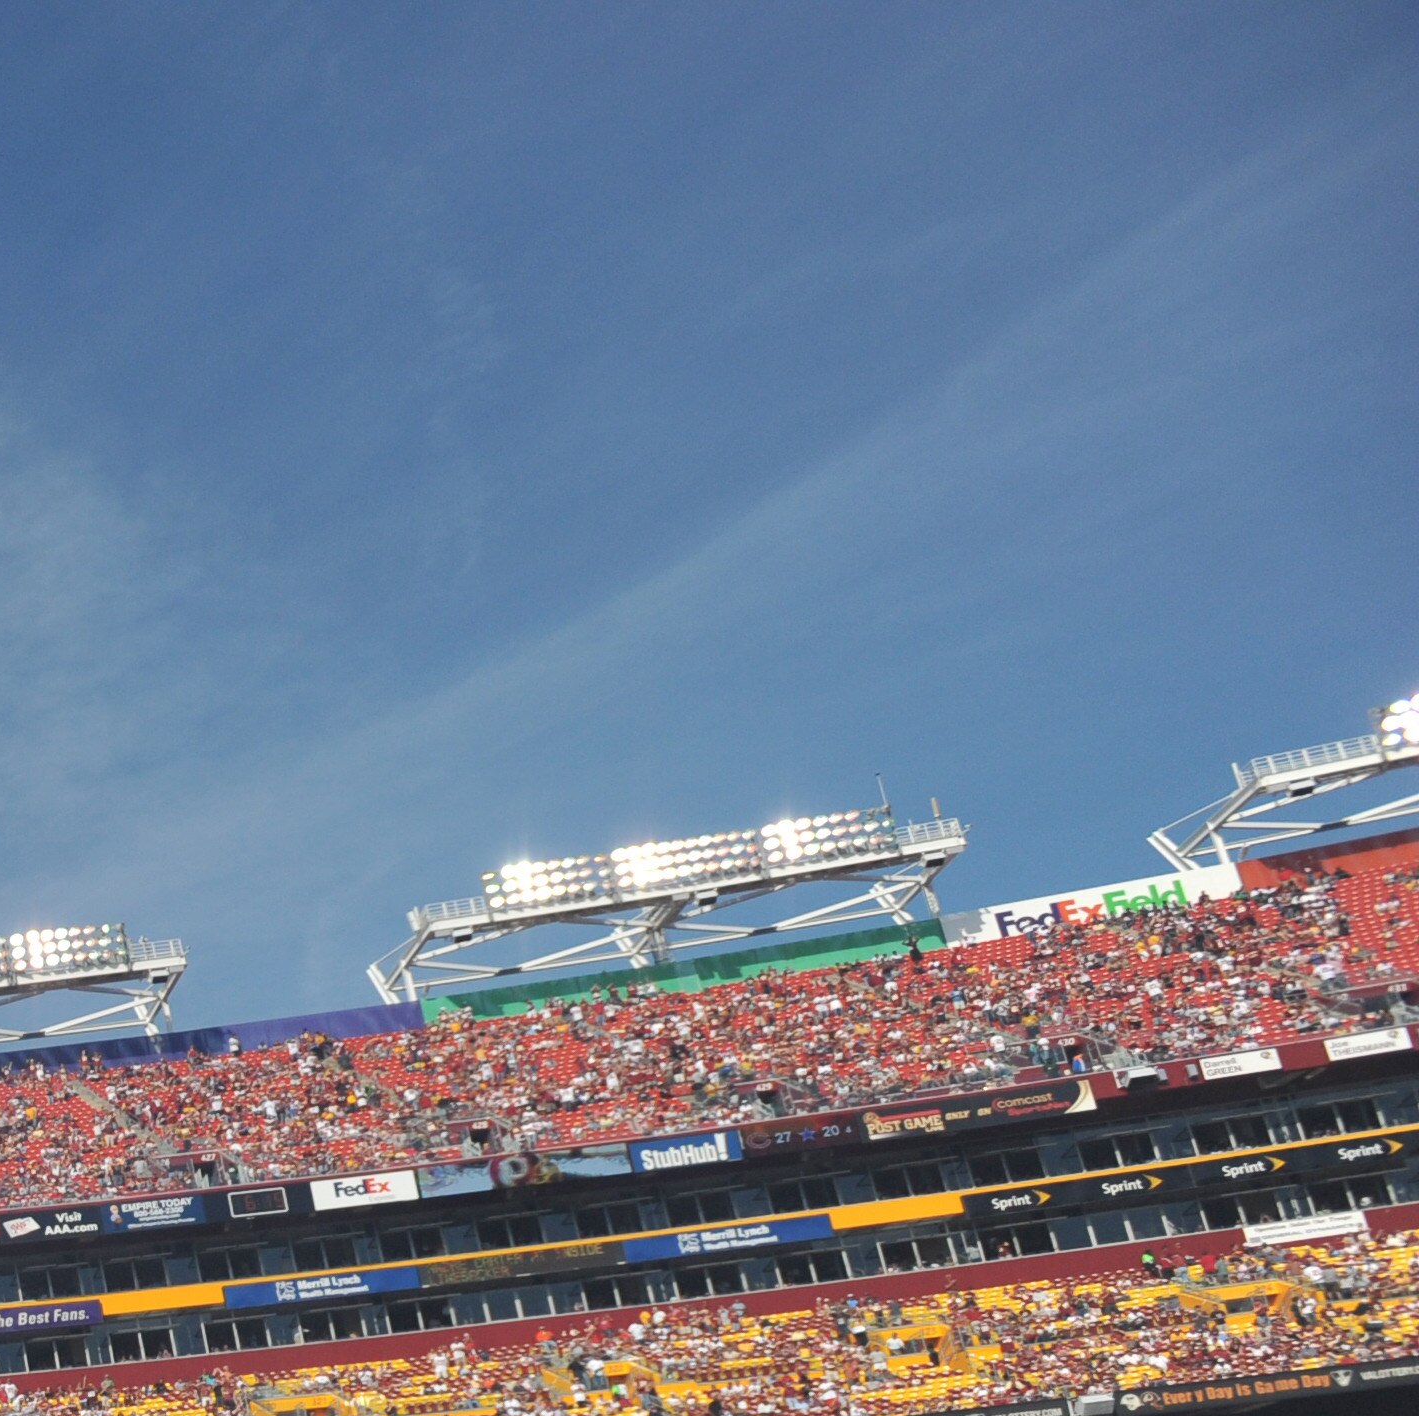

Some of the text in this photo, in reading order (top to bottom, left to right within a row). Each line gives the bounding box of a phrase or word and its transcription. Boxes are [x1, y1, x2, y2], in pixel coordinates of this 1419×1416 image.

[1206, 1066, 1243, 1078] GREEN
[995, 1092, 1054, 1110] comcast
[945, 1107, 991, 1121] ONLY ON
[867, 1114, 943, 1136] POST GAME
[775, 1131, 791, 1144] 27
[822, 1125, 840, 1138] 20
[641, 1132, 729, 1171] StubHub!
[1338, 1142, 1383, 1161] Sprint
[1222, 1160, 1266, 1178] Sprint
[333, 1178, 392, 1198] FedEx
[1101, 1178, 1143, 1195] Sprint
[121, 1196, 193, 1213] EMPIRE TODAY
[991, 1193, 1032, 1211] Sprint
[55, 1211, 82, 1223] Visit
[44, 1223, 98, 1236] AAA.com
[738, 1225, 770, 1239] Lynch
[332, 1275, 361, 1289] Lynch
[18, 1309, 50, 1325] Best
[54, 1305, 90, 1322] Fans.
[1163, 1388, 1203, 1406] Every
[1207, 1385, 1233, 1400] Day
[1255, 1376, 1299, 1394] Game
[1302, 1373, 1331, 1389] Day
